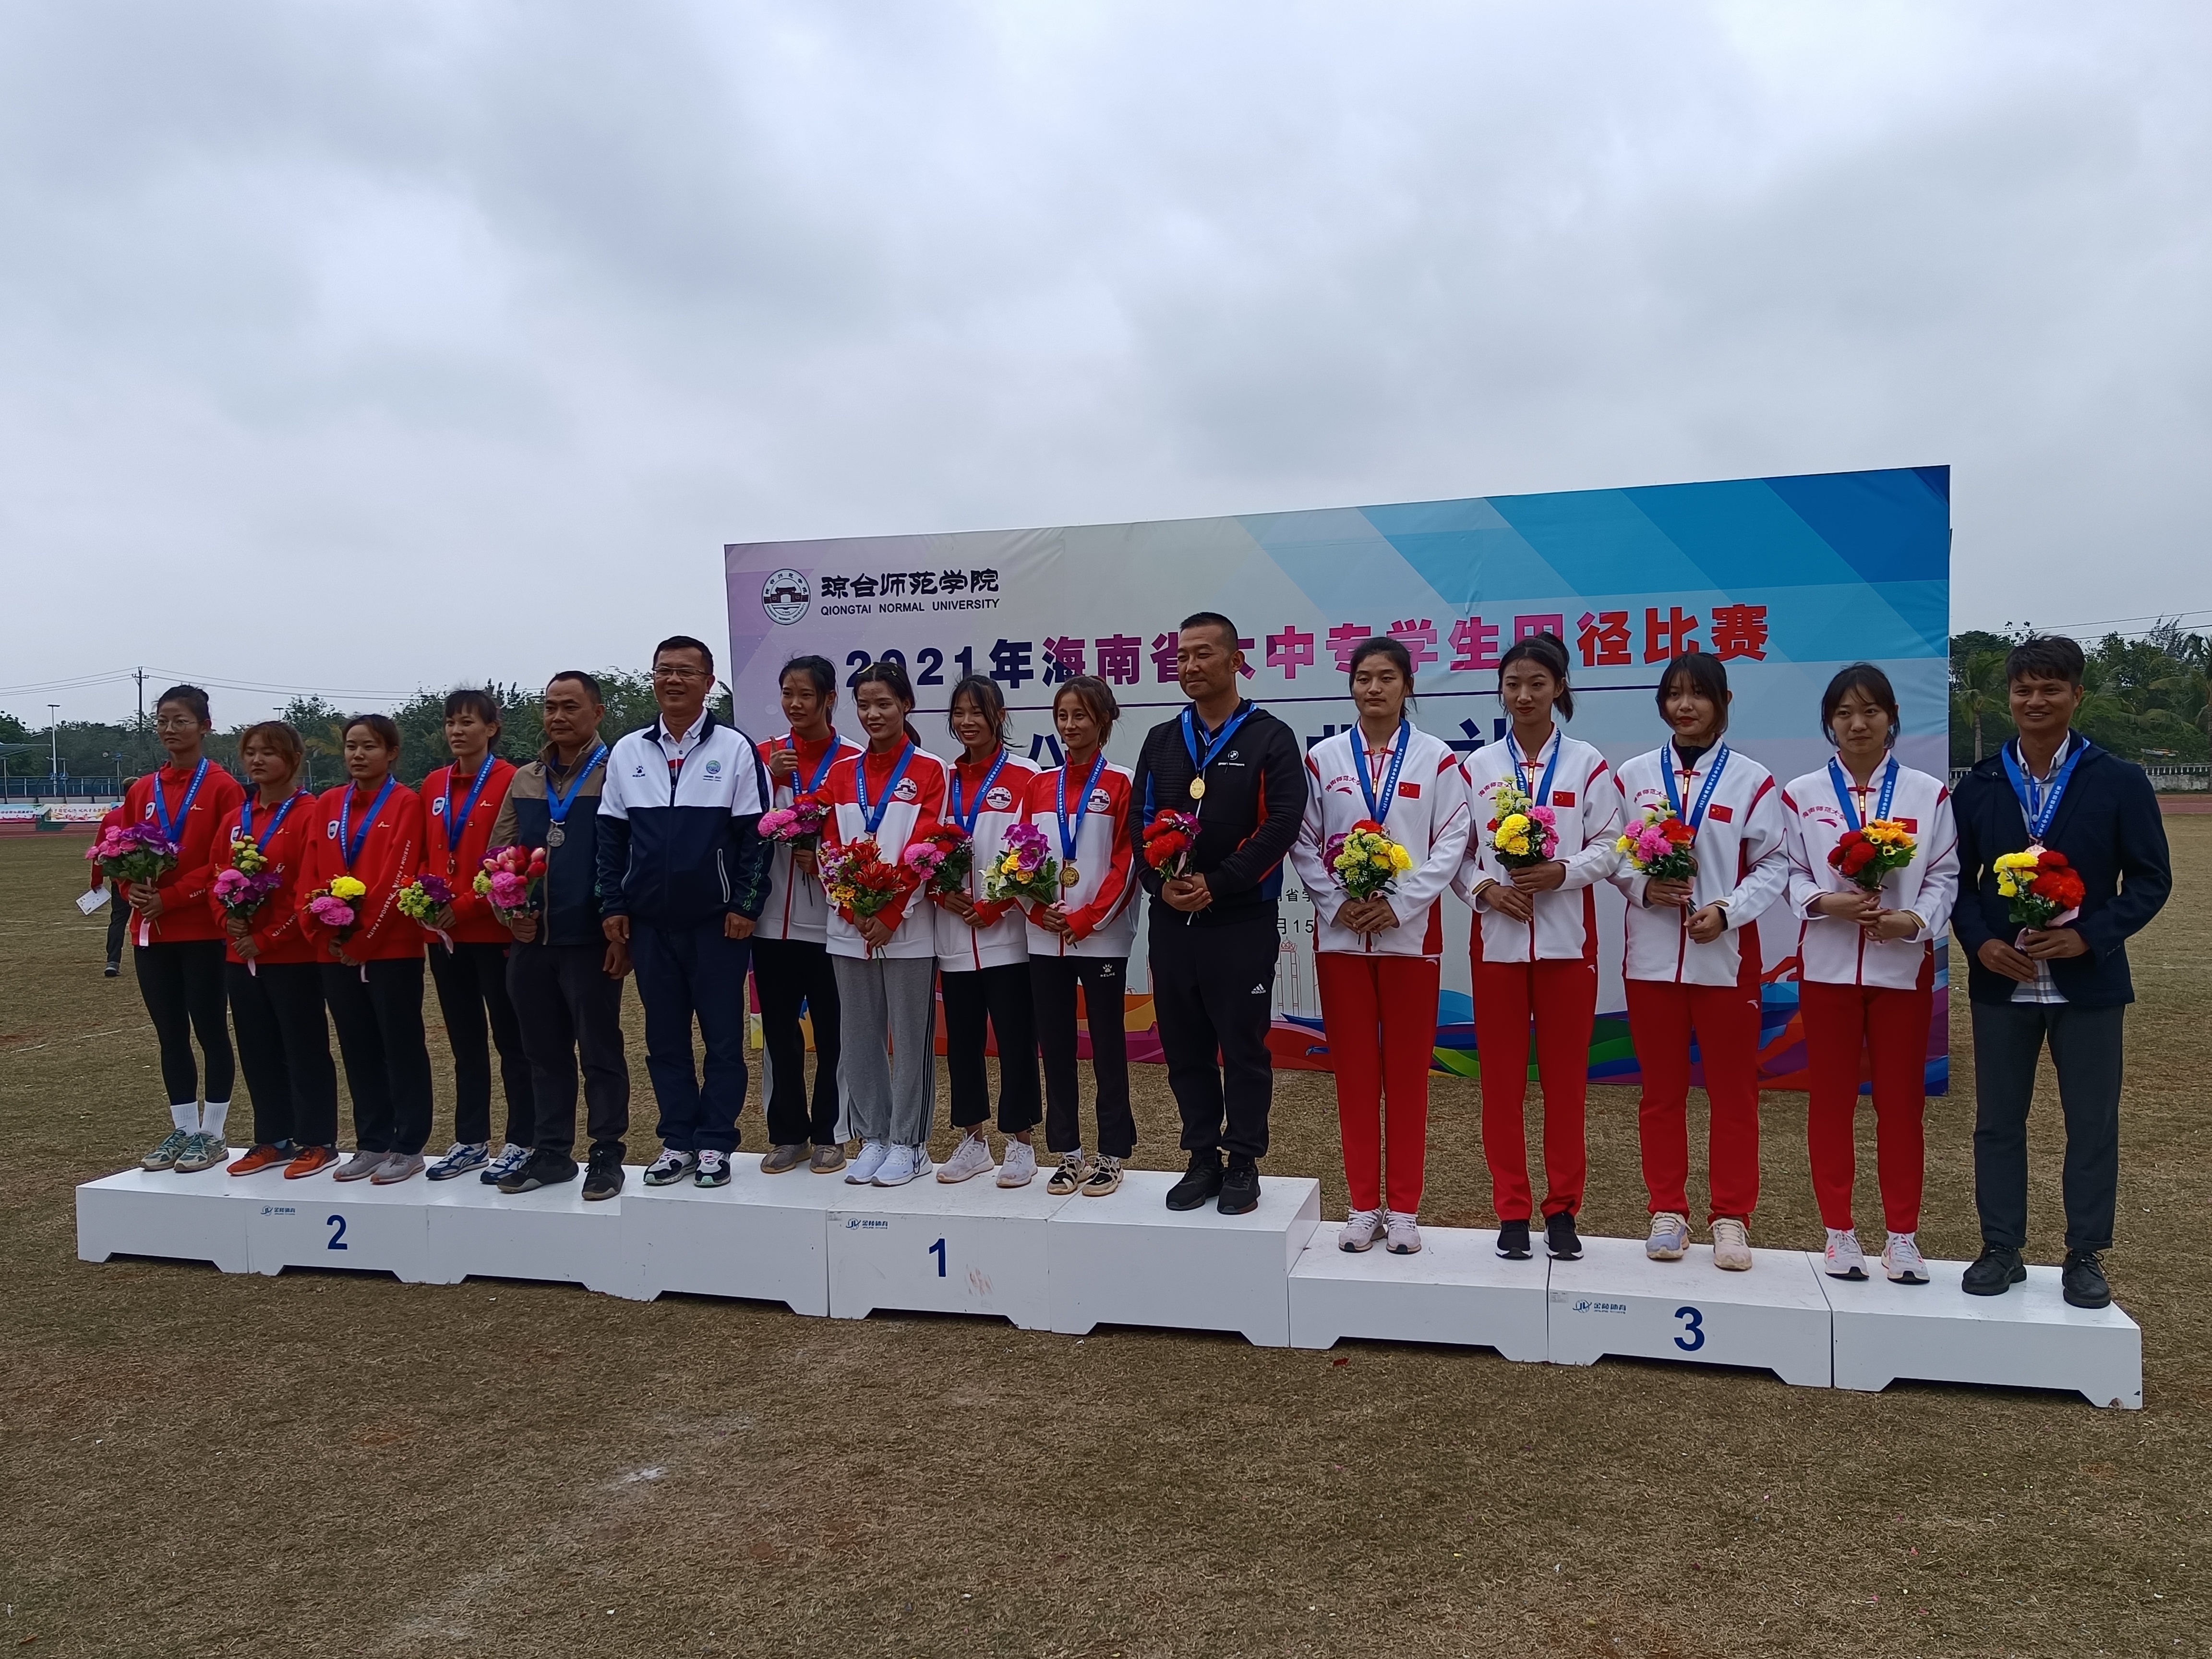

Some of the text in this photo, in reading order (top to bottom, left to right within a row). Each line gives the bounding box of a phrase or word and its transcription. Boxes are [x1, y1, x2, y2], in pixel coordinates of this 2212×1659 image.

[821, 568, 999, 599] 琼台师范学院
[821, 599, 1000, 616] QIONGTAI NORMAL UNIVERSITY
[401, 840, 411, 865] PASSION
[366, 923, 379, 939] FAITH
[326, 1214, 348, 1250] 2
[929, 1238, 946, 1277] 1
[1674, 1306, 1705, 1351] 3
